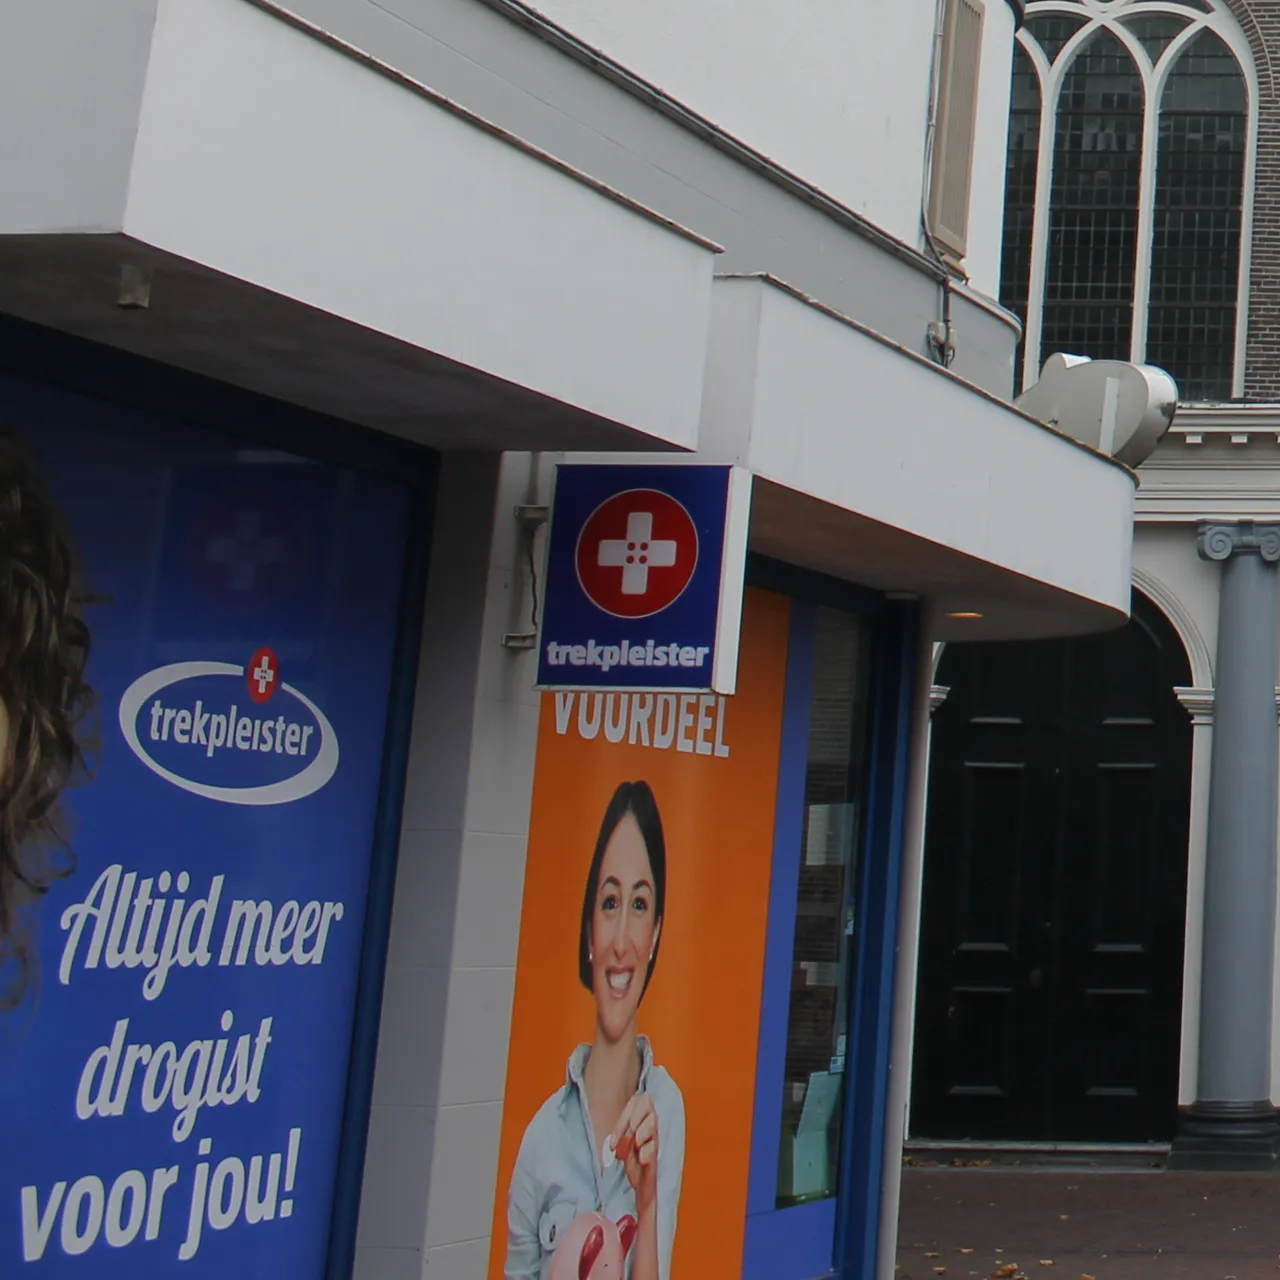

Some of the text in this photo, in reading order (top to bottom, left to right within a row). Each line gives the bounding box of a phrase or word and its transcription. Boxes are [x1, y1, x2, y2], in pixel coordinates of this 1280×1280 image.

[547, 639, 709, 671] trekpleister
[150, 699, 313, 757] trekpleister
[59, 864, 344, 1001] Altijd meer
[75, 1009, 273, 1143] drogist
[20, 1127, 302, 1262] voor jou!
